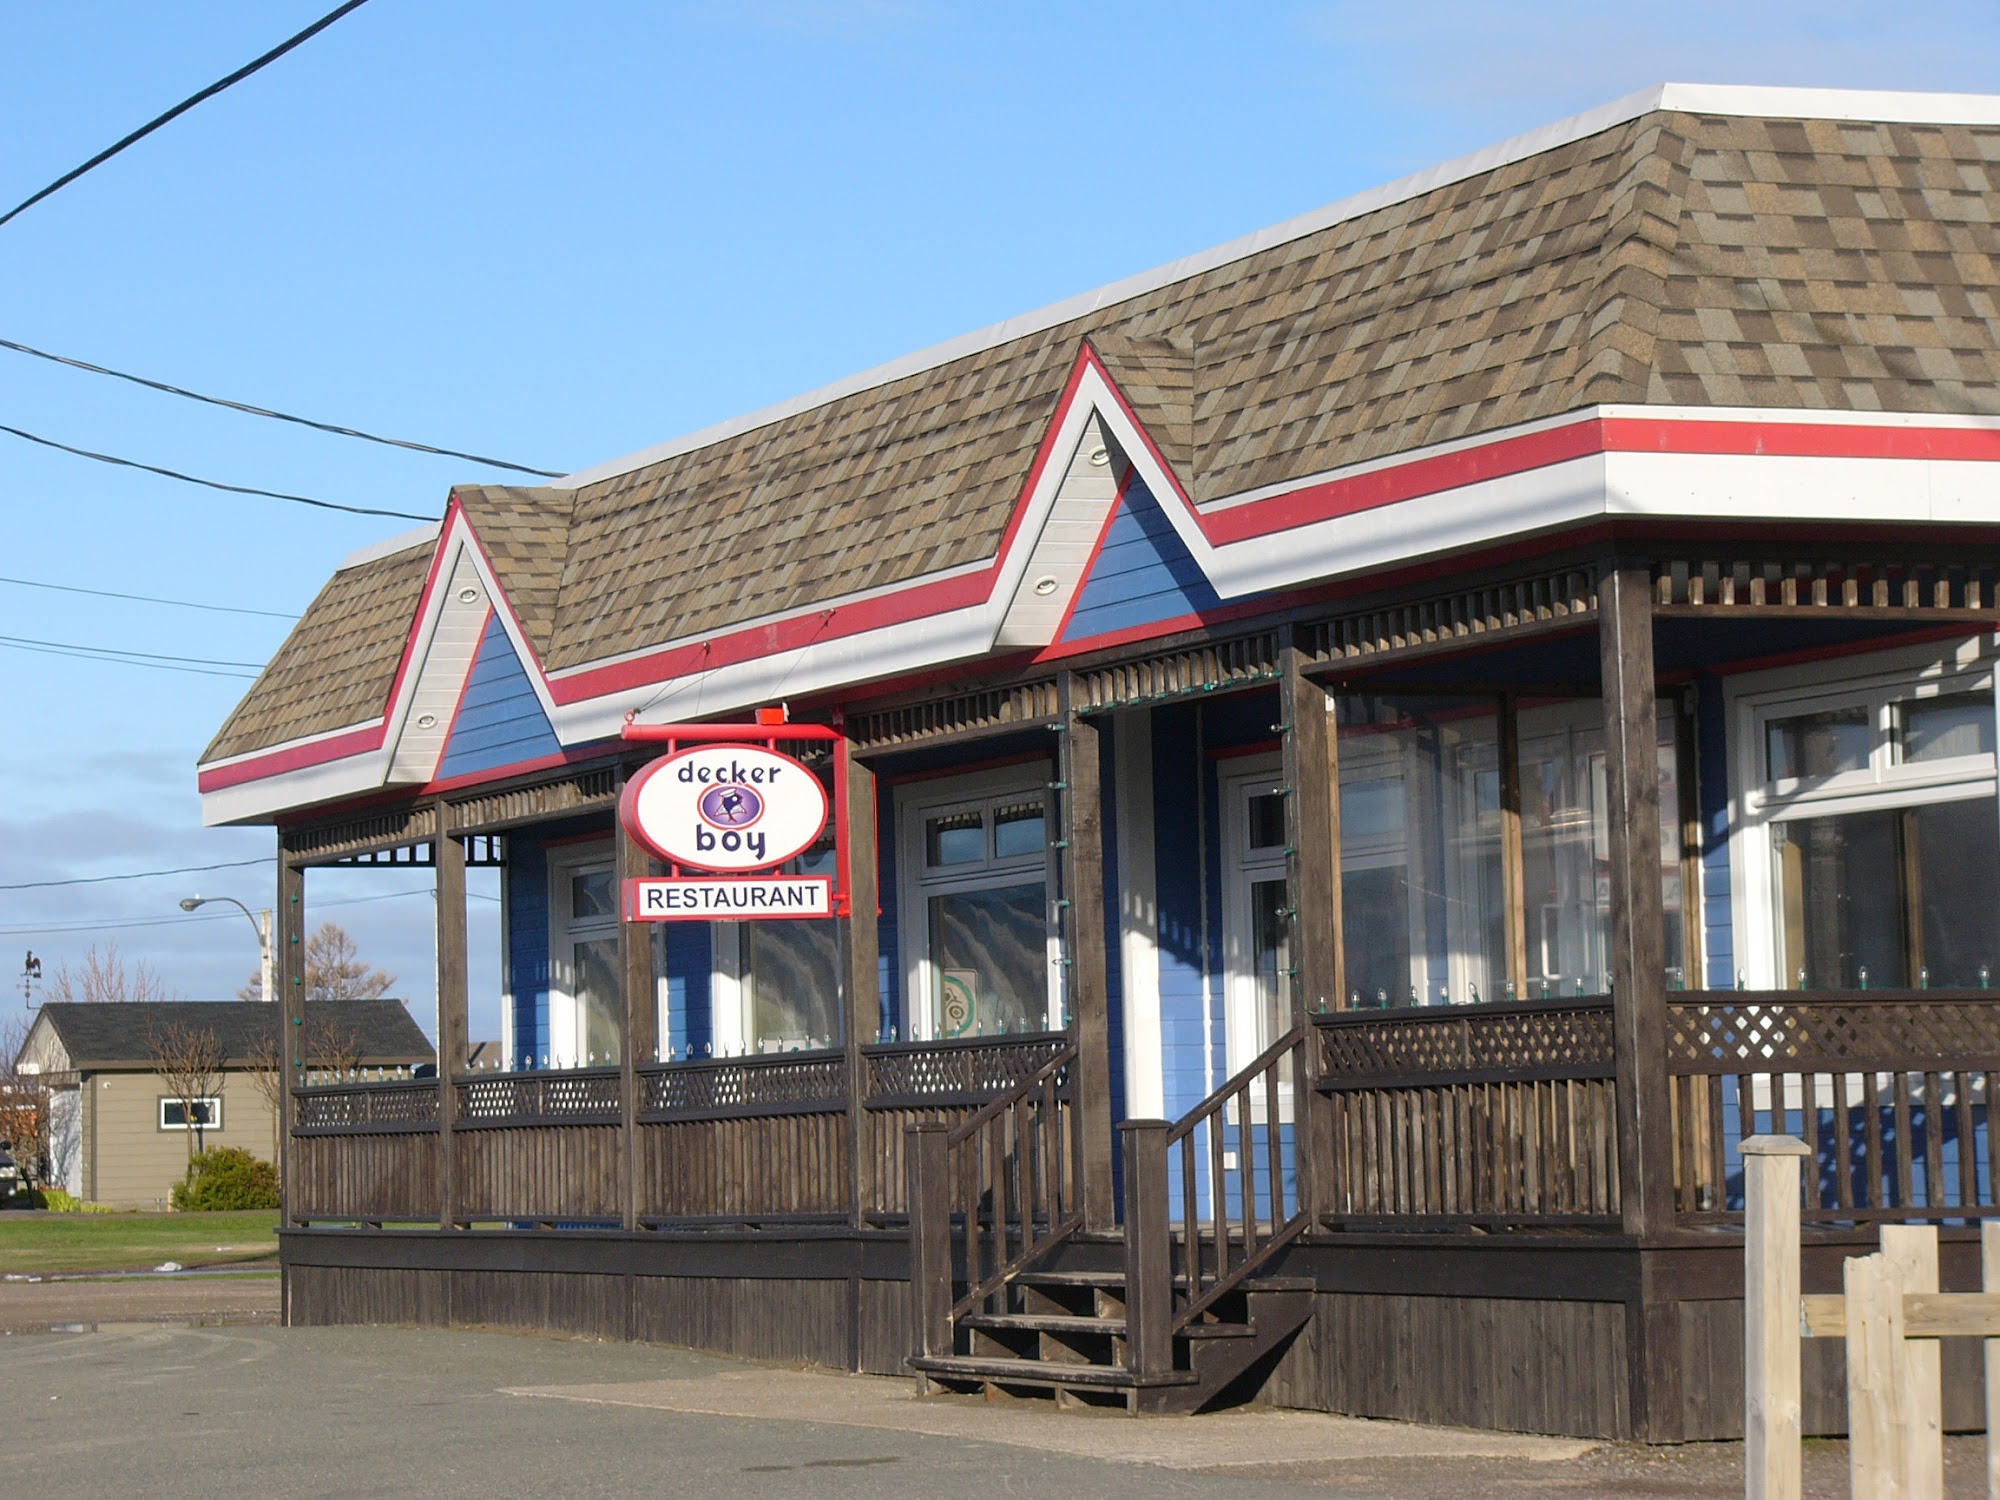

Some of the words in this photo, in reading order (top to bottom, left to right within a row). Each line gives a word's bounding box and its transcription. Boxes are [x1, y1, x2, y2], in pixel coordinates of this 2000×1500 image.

[678, 760, 782, 784] decker
[696, 823, 766, 861] boy
[648, 886, 820, 909] RESTAURANT
